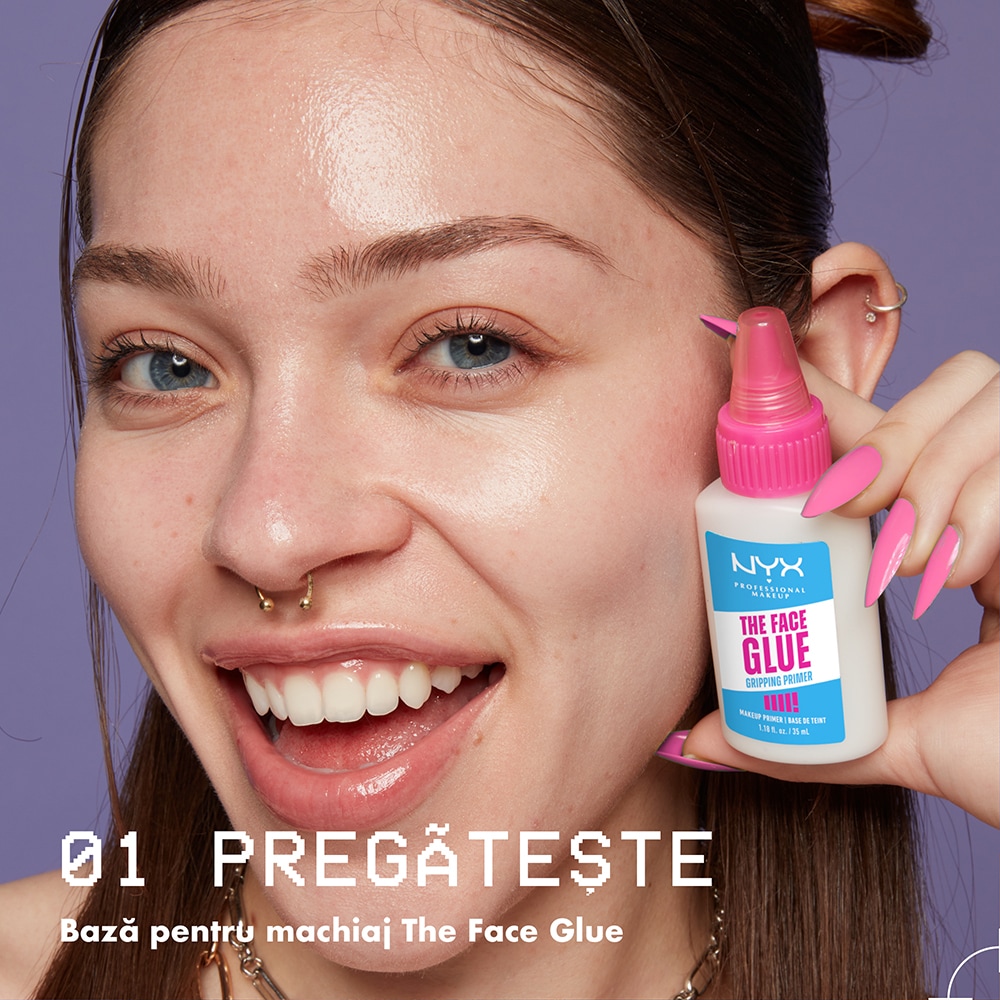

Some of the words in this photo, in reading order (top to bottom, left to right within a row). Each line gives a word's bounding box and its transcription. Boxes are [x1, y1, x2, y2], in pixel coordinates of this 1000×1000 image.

[731, 552, 804, 577] NYX
[734, 581, 806, 593] PROFESSIONAL
[752, 591, 790, 600] MAKEUP
[739, 615, 767, 636] THE
[771, 609, 808, 634] FACE
[742, 631, 811, 675] GLUE
[745, 675, 782, 688] GRIPPING
[783, 671, 813, 685] PRIMER
[739, 708, 761, 720] MAKEUP
[763, 714, 783, 724] PRIMER
[788, 717, 802, 725] BASE
[803, 717, 810, 725] DE
